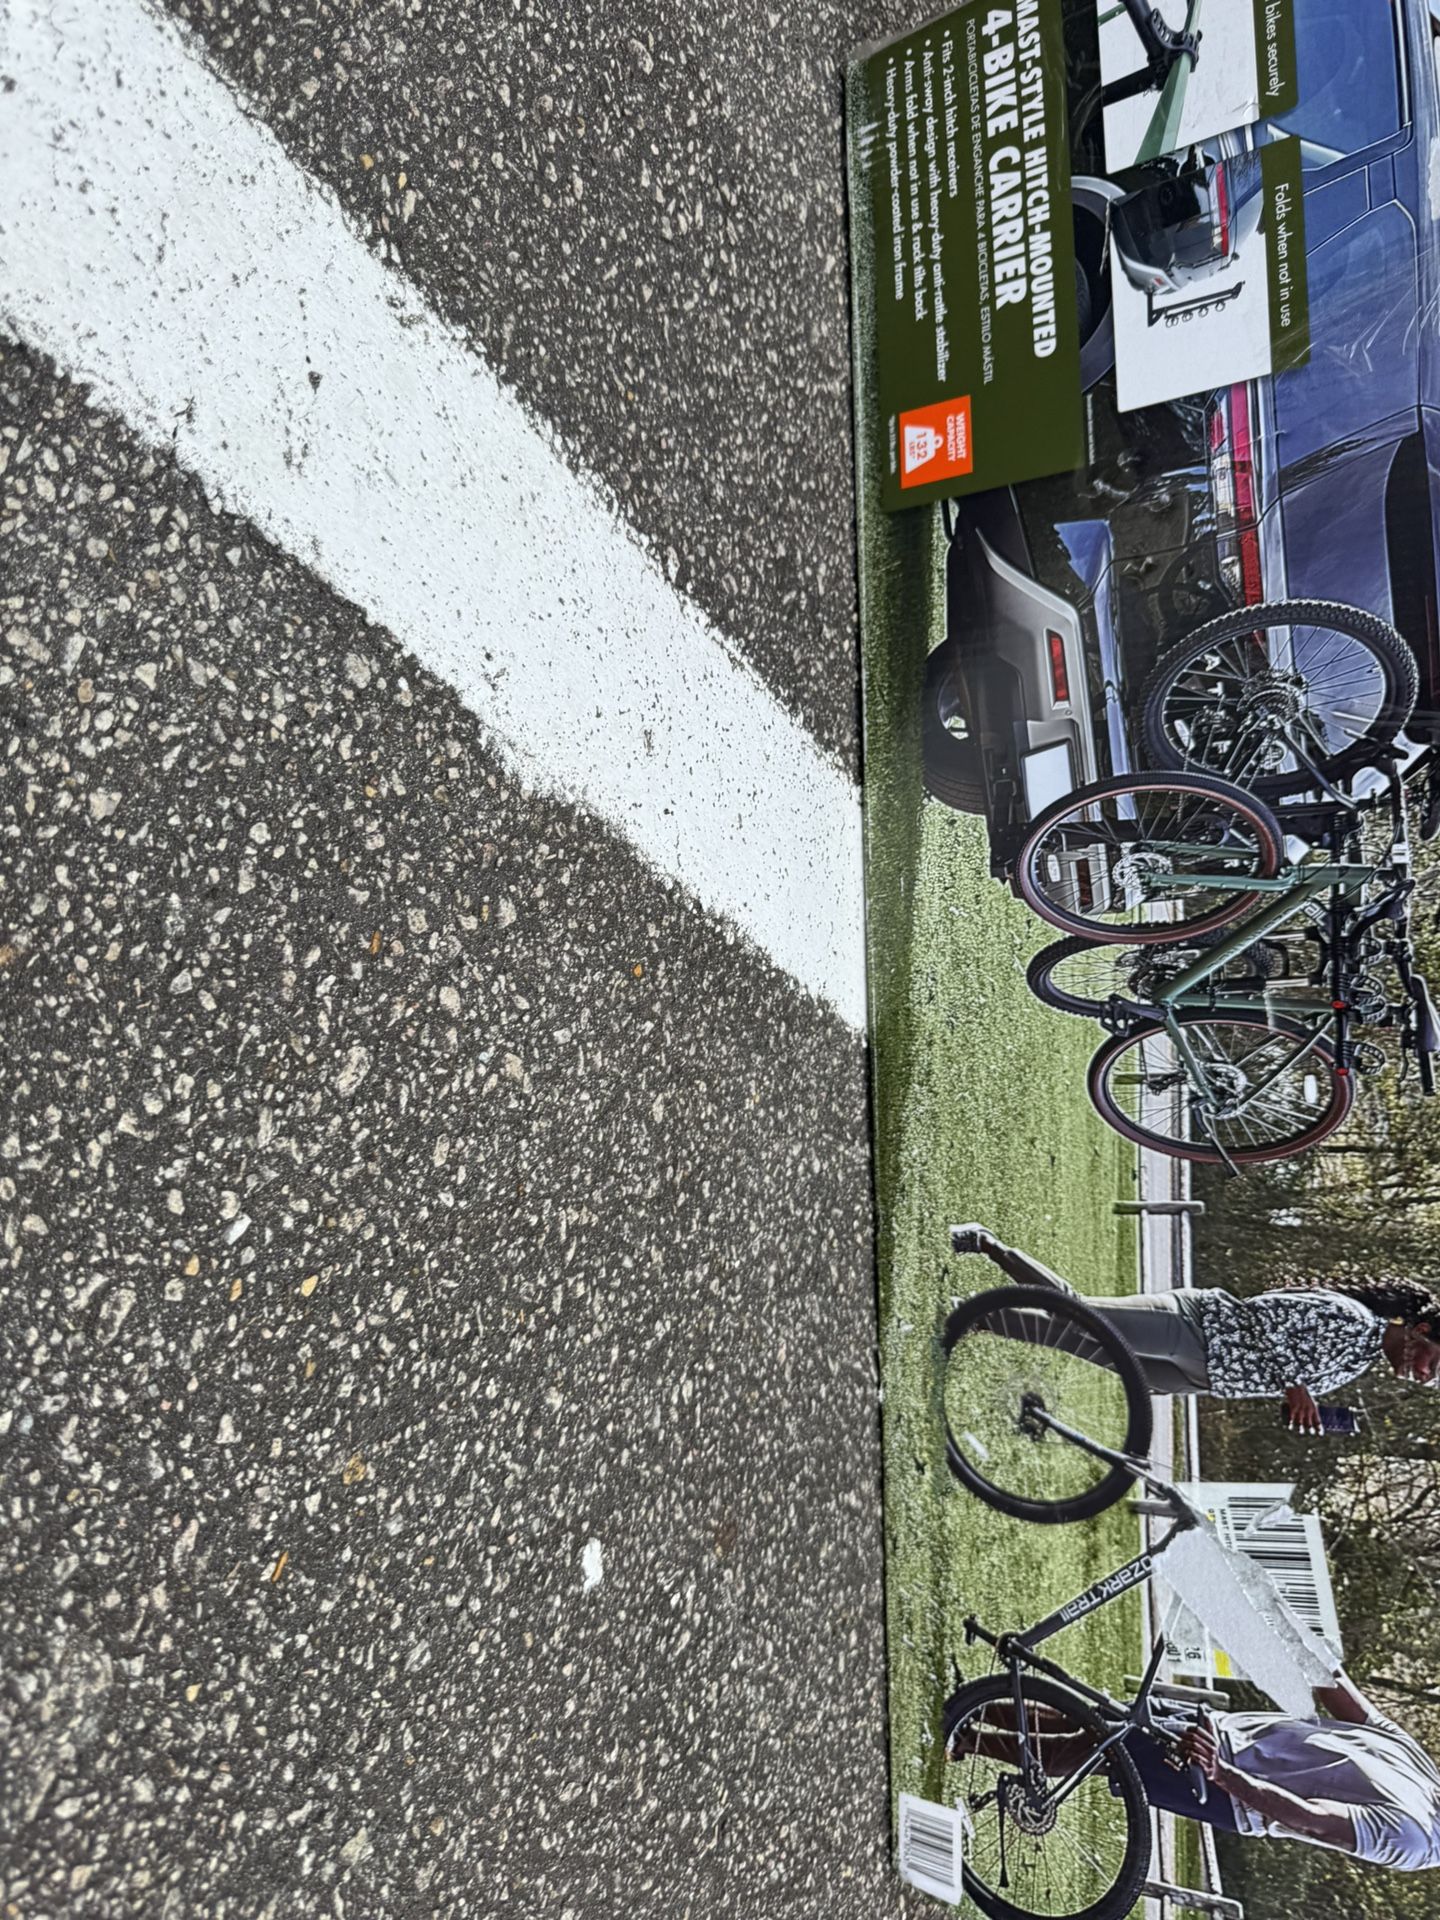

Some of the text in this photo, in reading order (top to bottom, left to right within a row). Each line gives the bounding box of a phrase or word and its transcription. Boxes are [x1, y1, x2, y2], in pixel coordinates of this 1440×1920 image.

[942, 40, 960, 198] Fits 2-inch hitch receivers
[1264, 0, 1286, 96] bikes securely
[884, 68, 906, 300] Heavy-duty powder-coated iron frame
[904, 60, 927, 322] Arms fold when not in use & rack tilts back
[922, 51, 948, 382] Anti-sway design with heavy-duty anti-rattle stabilizer
[966, 18, 994, 384] PORTABICICLETAS DE ENGANCHE PARA 4 BICICLETAS, ESTILO MÁSTIL
[982, 9, 1027, 310] 4-BIKE CARRIER
[1016, 0, 1056, 358] MAST-STYLE HITCH-MOUNTED
[1274, 183, 1293, 327] Folds when not in use
[916, 432, 928, 460] 132
[946, 414, 956, 462] CAPACITY
[956, 412, 966, 458] WEIGHT
